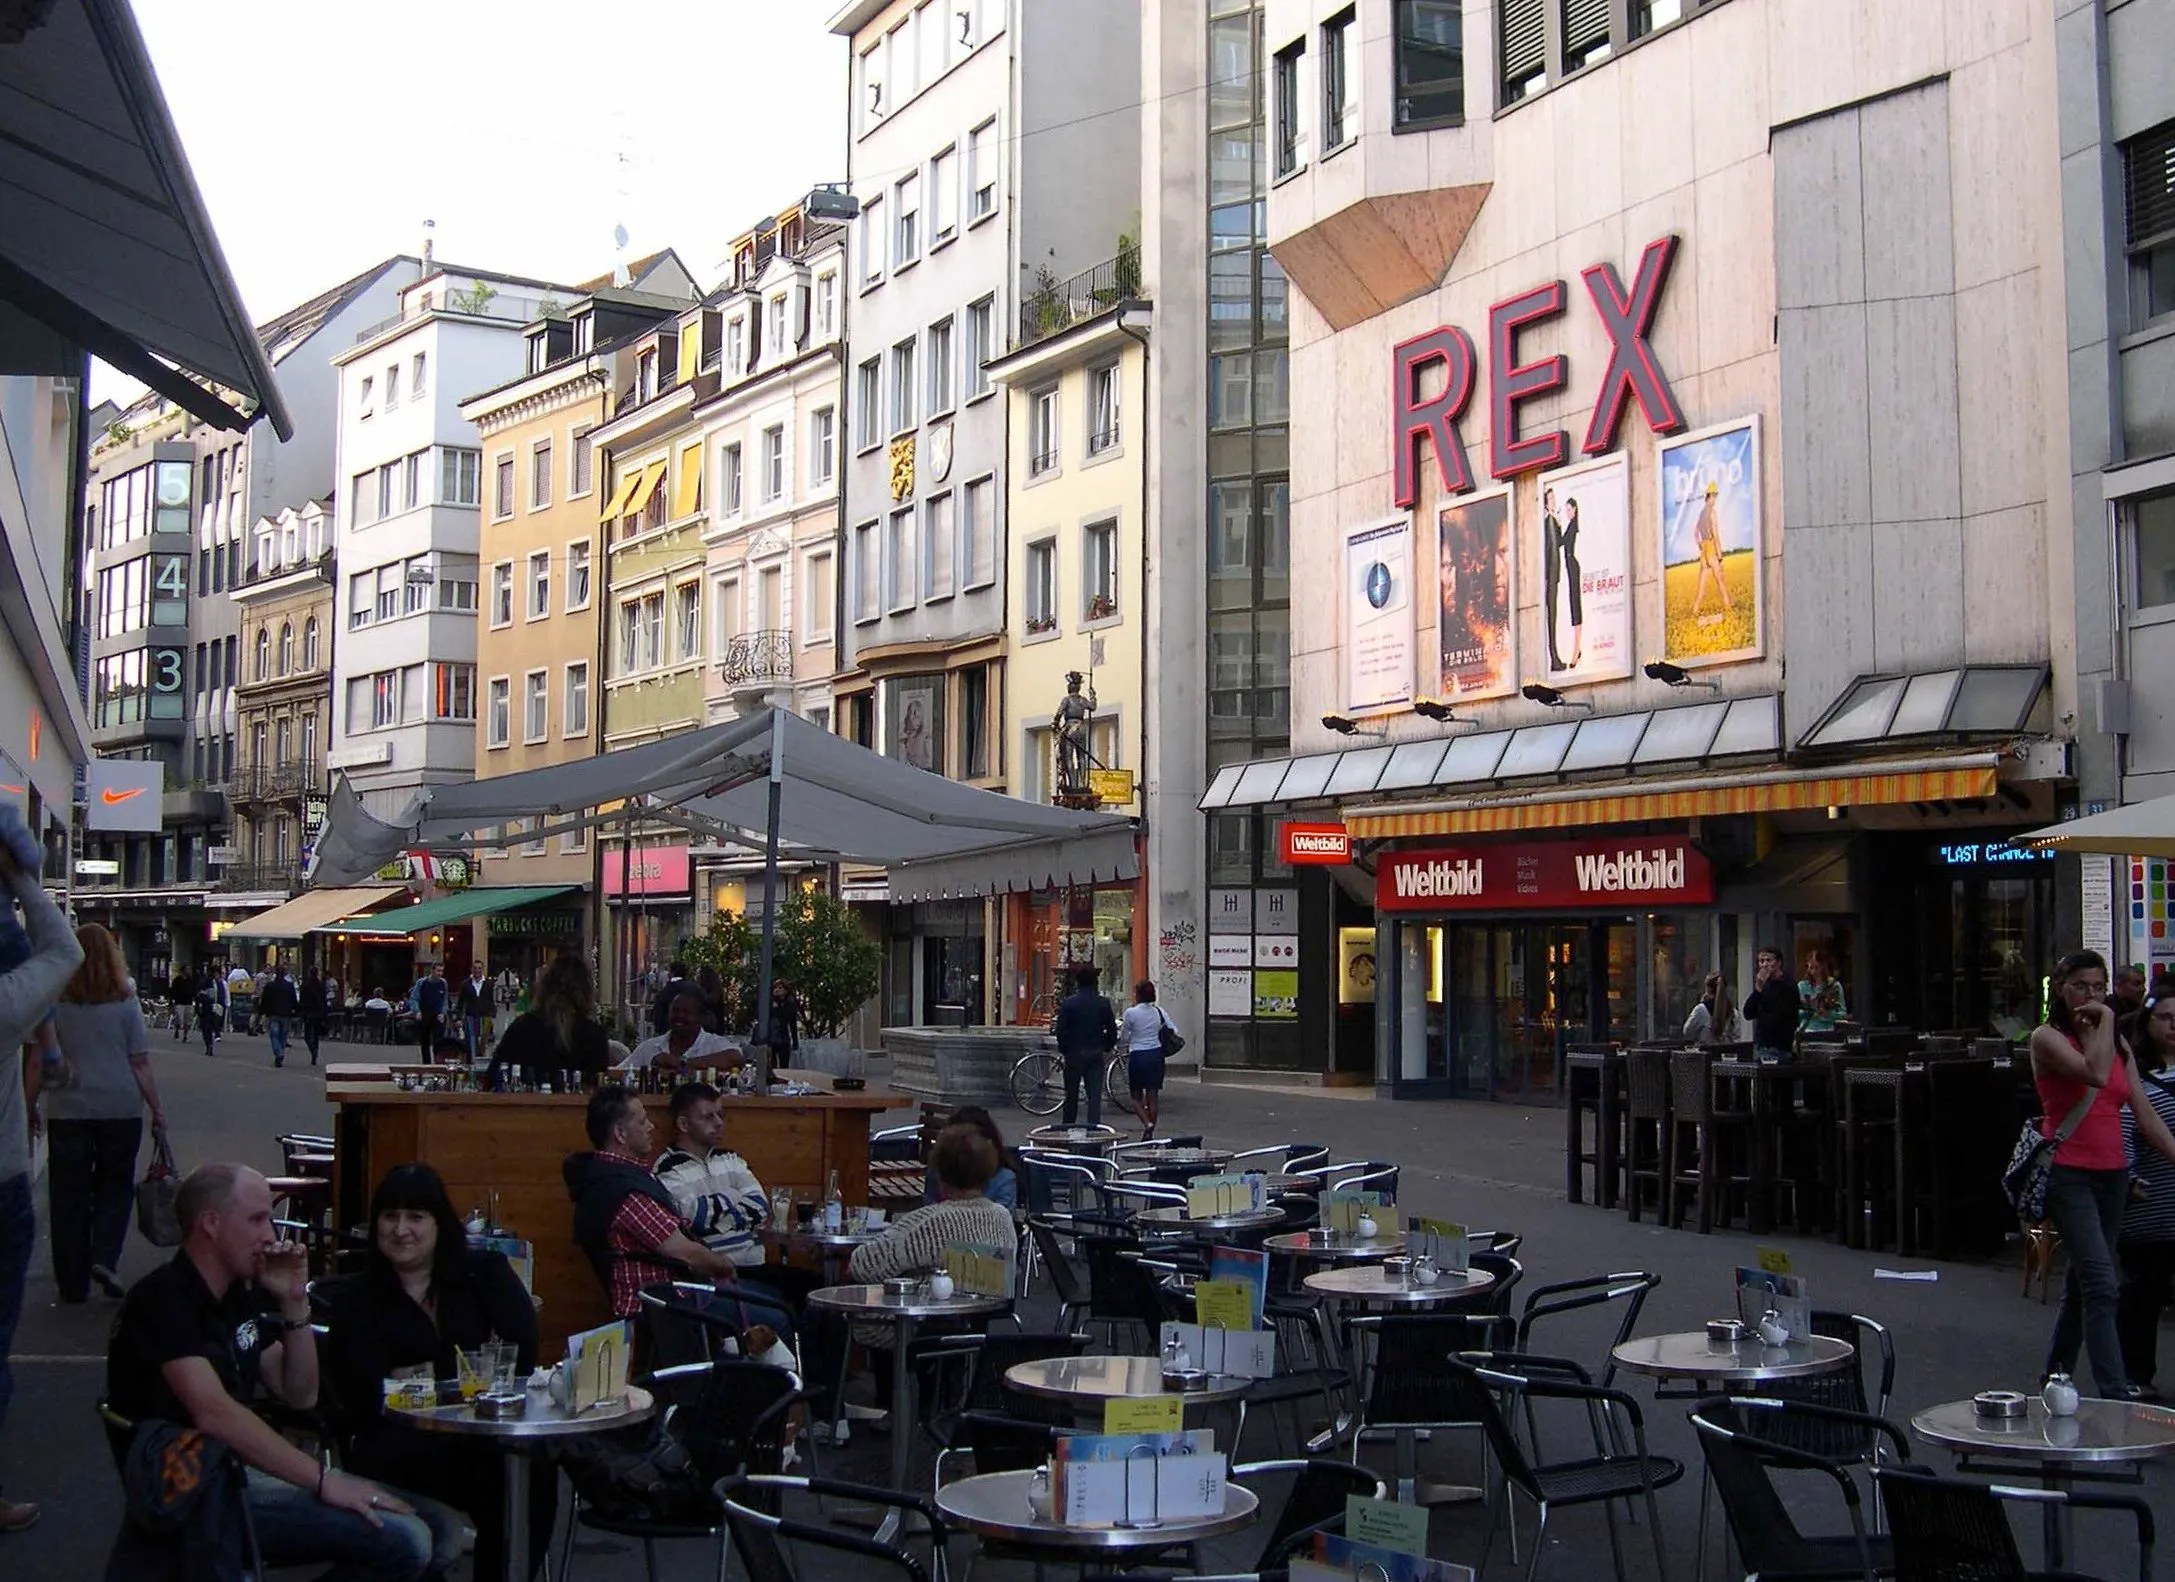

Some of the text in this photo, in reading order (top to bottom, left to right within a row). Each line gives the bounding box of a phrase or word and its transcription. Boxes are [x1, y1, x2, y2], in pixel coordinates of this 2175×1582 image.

[1393, 235, 1685, 508] REX
[159, 462, 190, 506] 5
[155, 556, 187, 599] 4
[1597, 575, 1624, 591] BRAUT
[154, 649, 182, 693] 3
[1293, 834, 1345, 854] Weltbild
[1394, 858, 1482, 897] Weltbild
[1575, 847, 1685, 891] Weltbild
[490, 917, 537, 932] TARBUCKS
